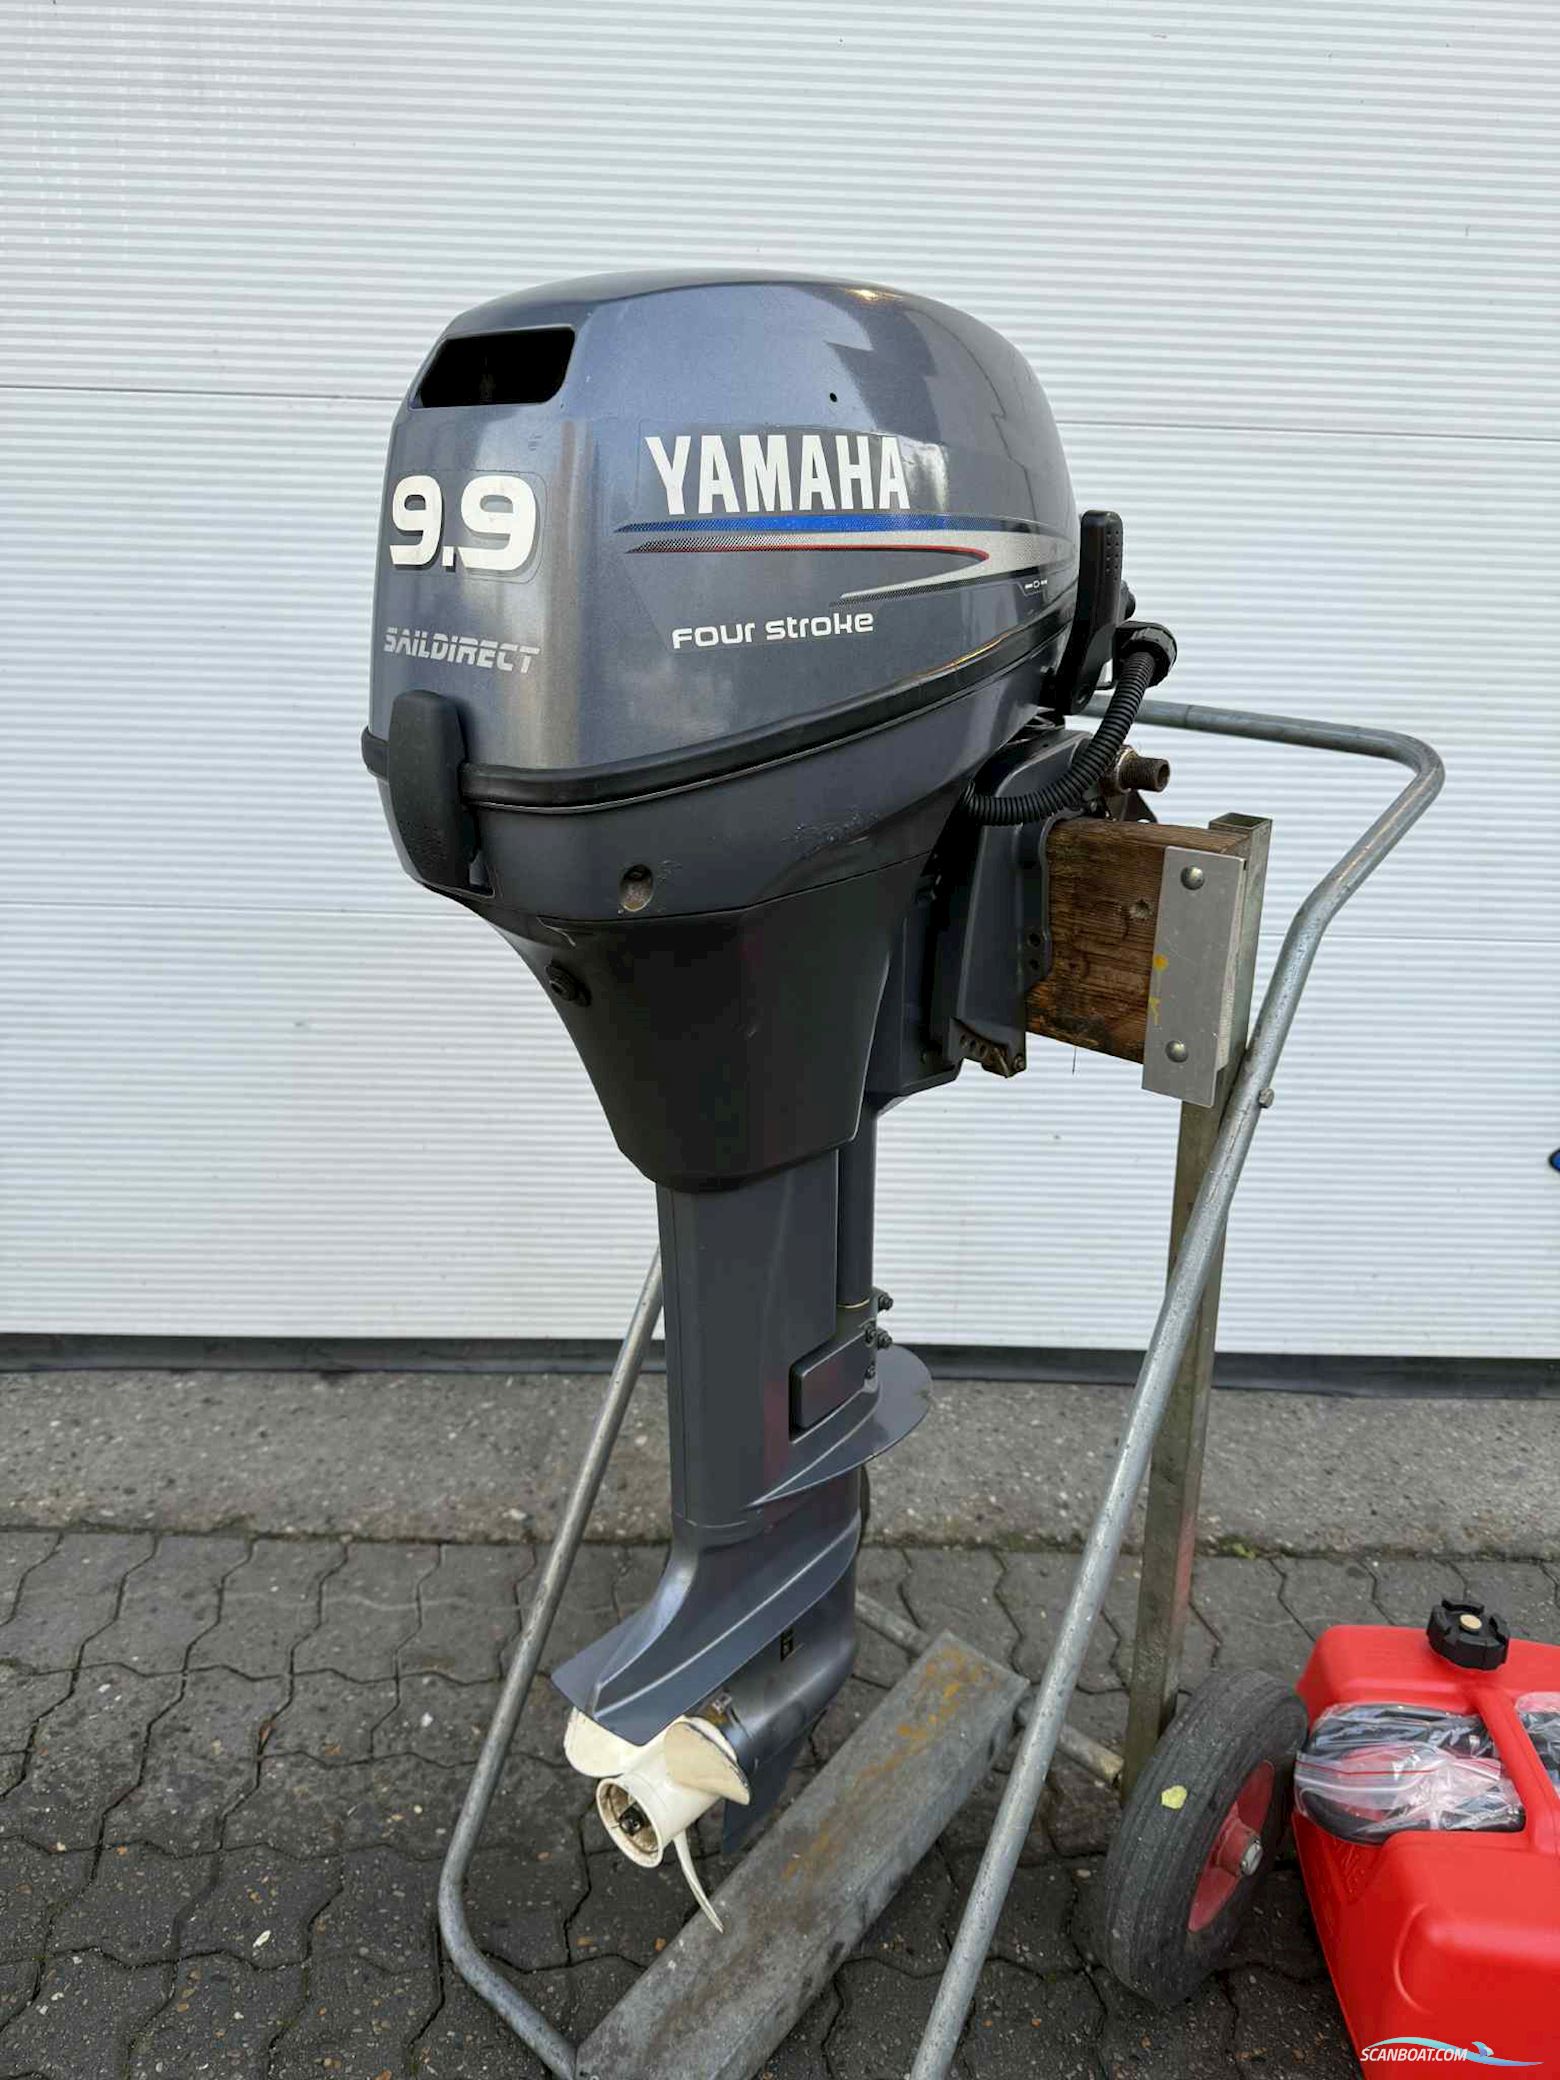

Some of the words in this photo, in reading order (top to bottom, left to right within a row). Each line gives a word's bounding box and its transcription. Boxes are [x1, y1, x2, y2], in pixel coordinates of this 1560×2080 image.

[645, 435, 910, 515] YAMAHA
[389, 474, 537, 572] 9.9
[384, 626, 540, 674] SAILDIRECT
